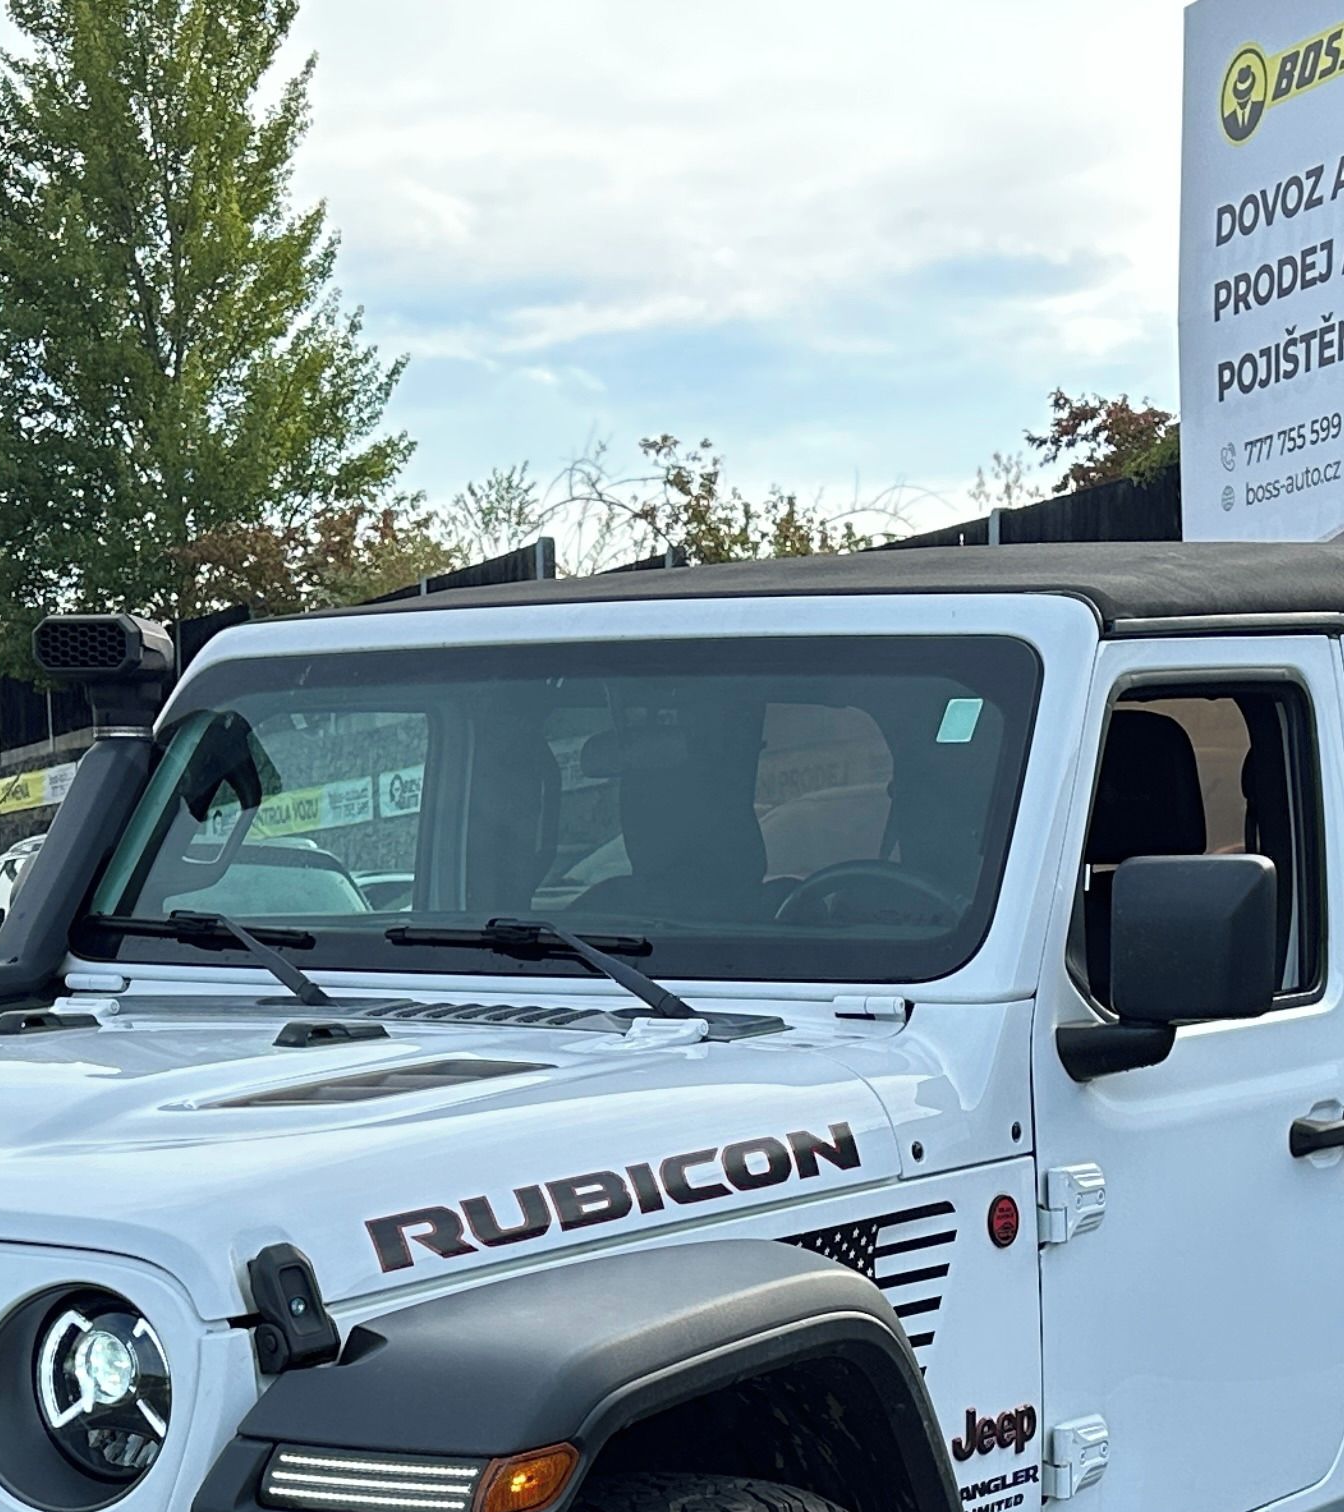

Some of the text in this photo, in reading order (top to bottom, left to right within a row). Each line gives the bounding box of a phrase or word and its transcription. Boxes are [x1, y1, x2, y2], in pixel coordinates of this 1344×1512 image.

[1215, 164, 1324, 247] DOVOZ
[1213, 238, 1334, 322] PRODEJ
[1244, 412, 1342, 466] 777 755 599
[1245, 460, 1342, 506] boss-auto.cz
[364, 1121, 861, 1273] RUBICON
[952, 1404, 1037, 1461] Jeep
